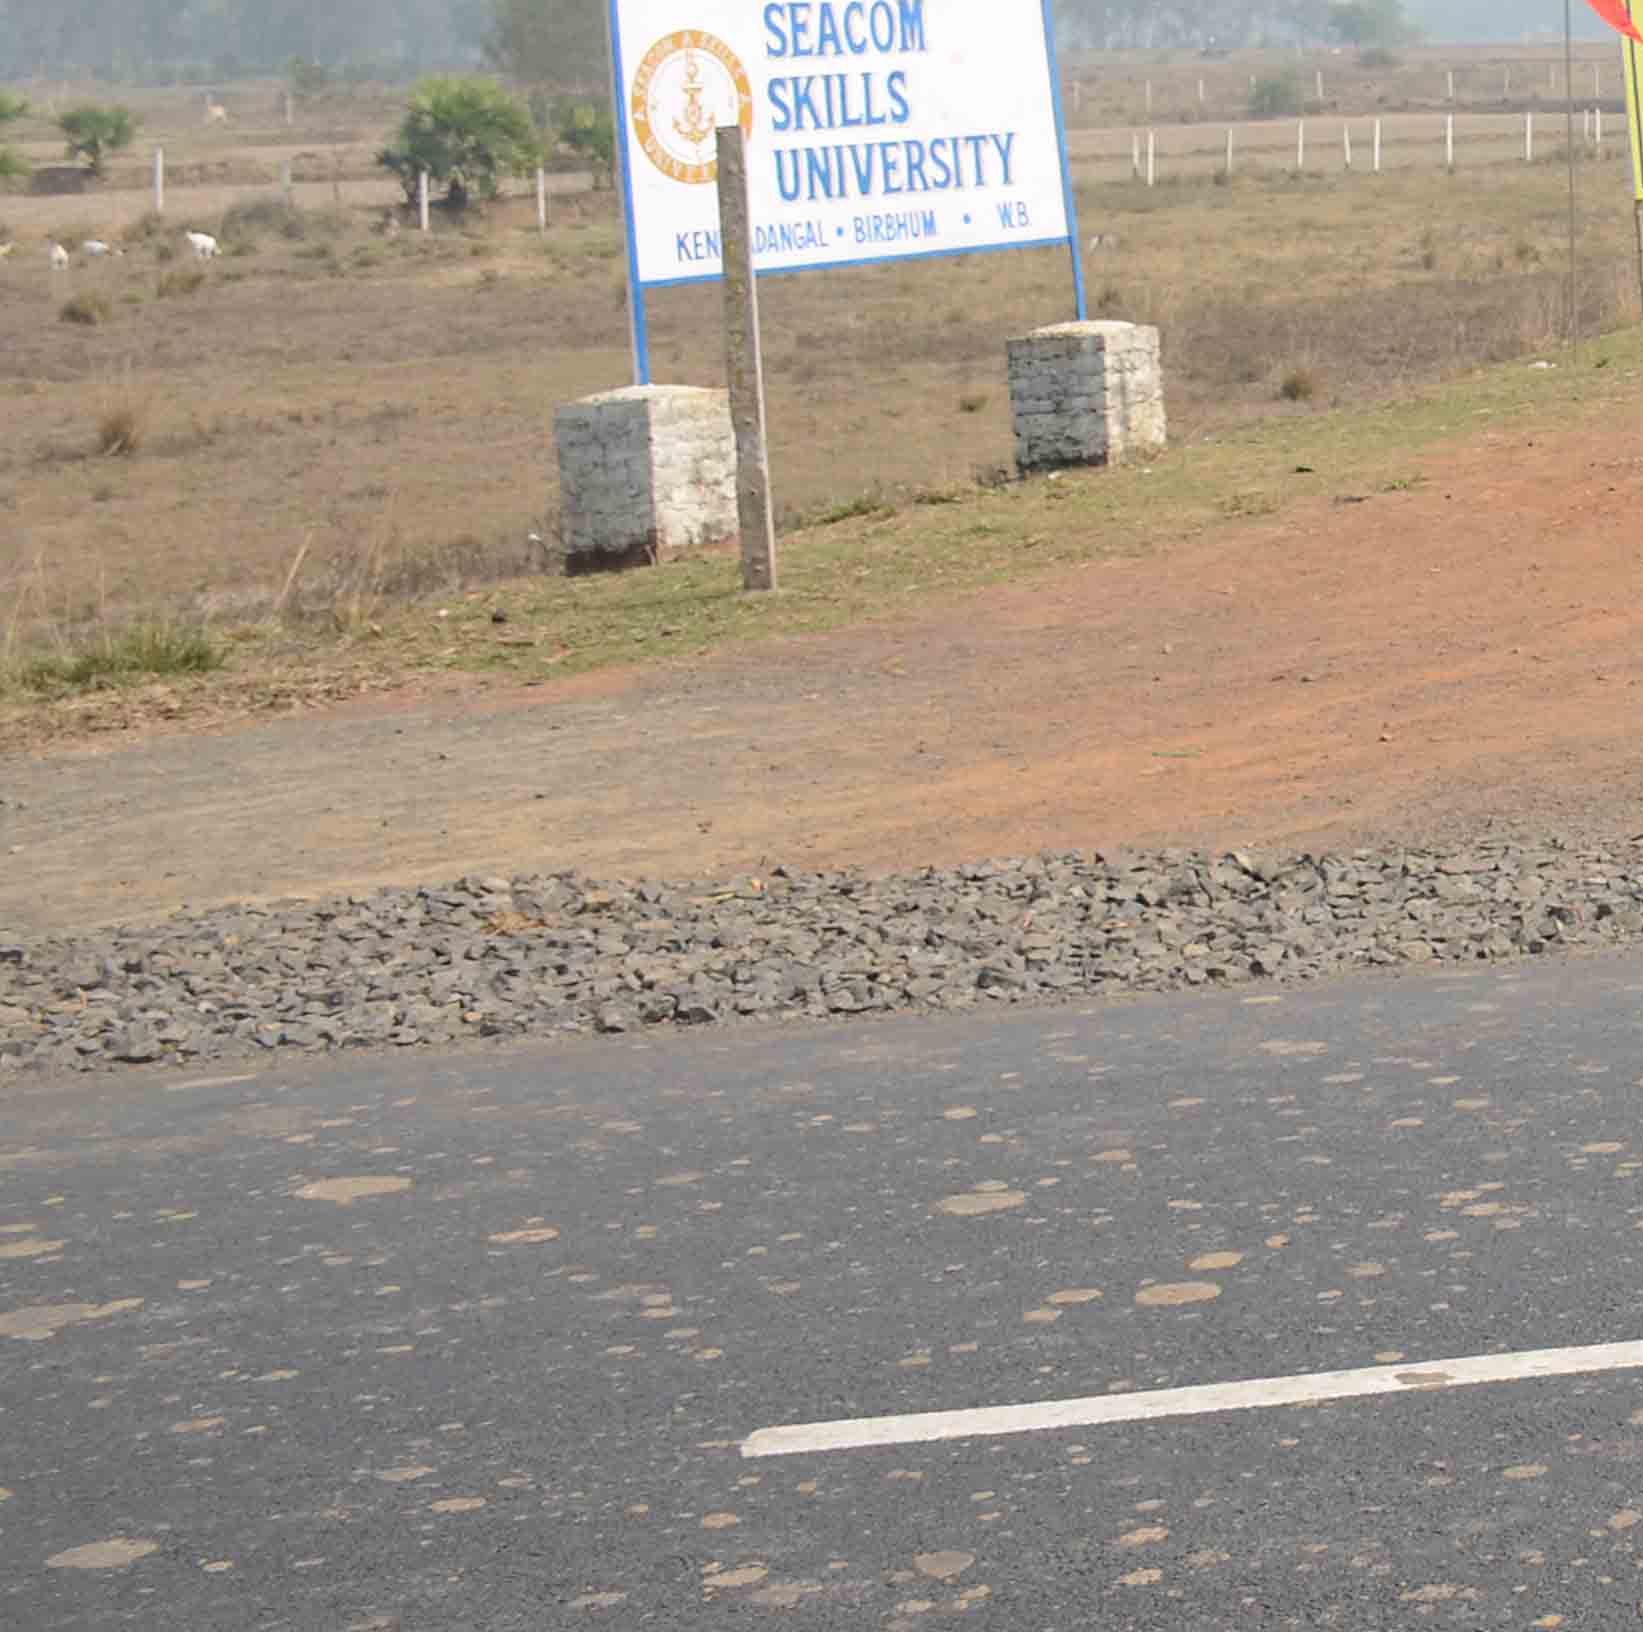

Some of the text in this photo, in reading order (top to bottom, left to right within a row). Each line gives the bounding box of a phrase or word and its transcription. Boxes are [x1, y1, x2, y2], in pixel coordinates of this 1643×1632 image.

[762, 0, 927, 58] SEACOM
[767, 69, 911, 132] SKILLS
[773, 131, 1016, 202] UNIVERSITY
[853, 210, 937, 243] BIRBHUM
